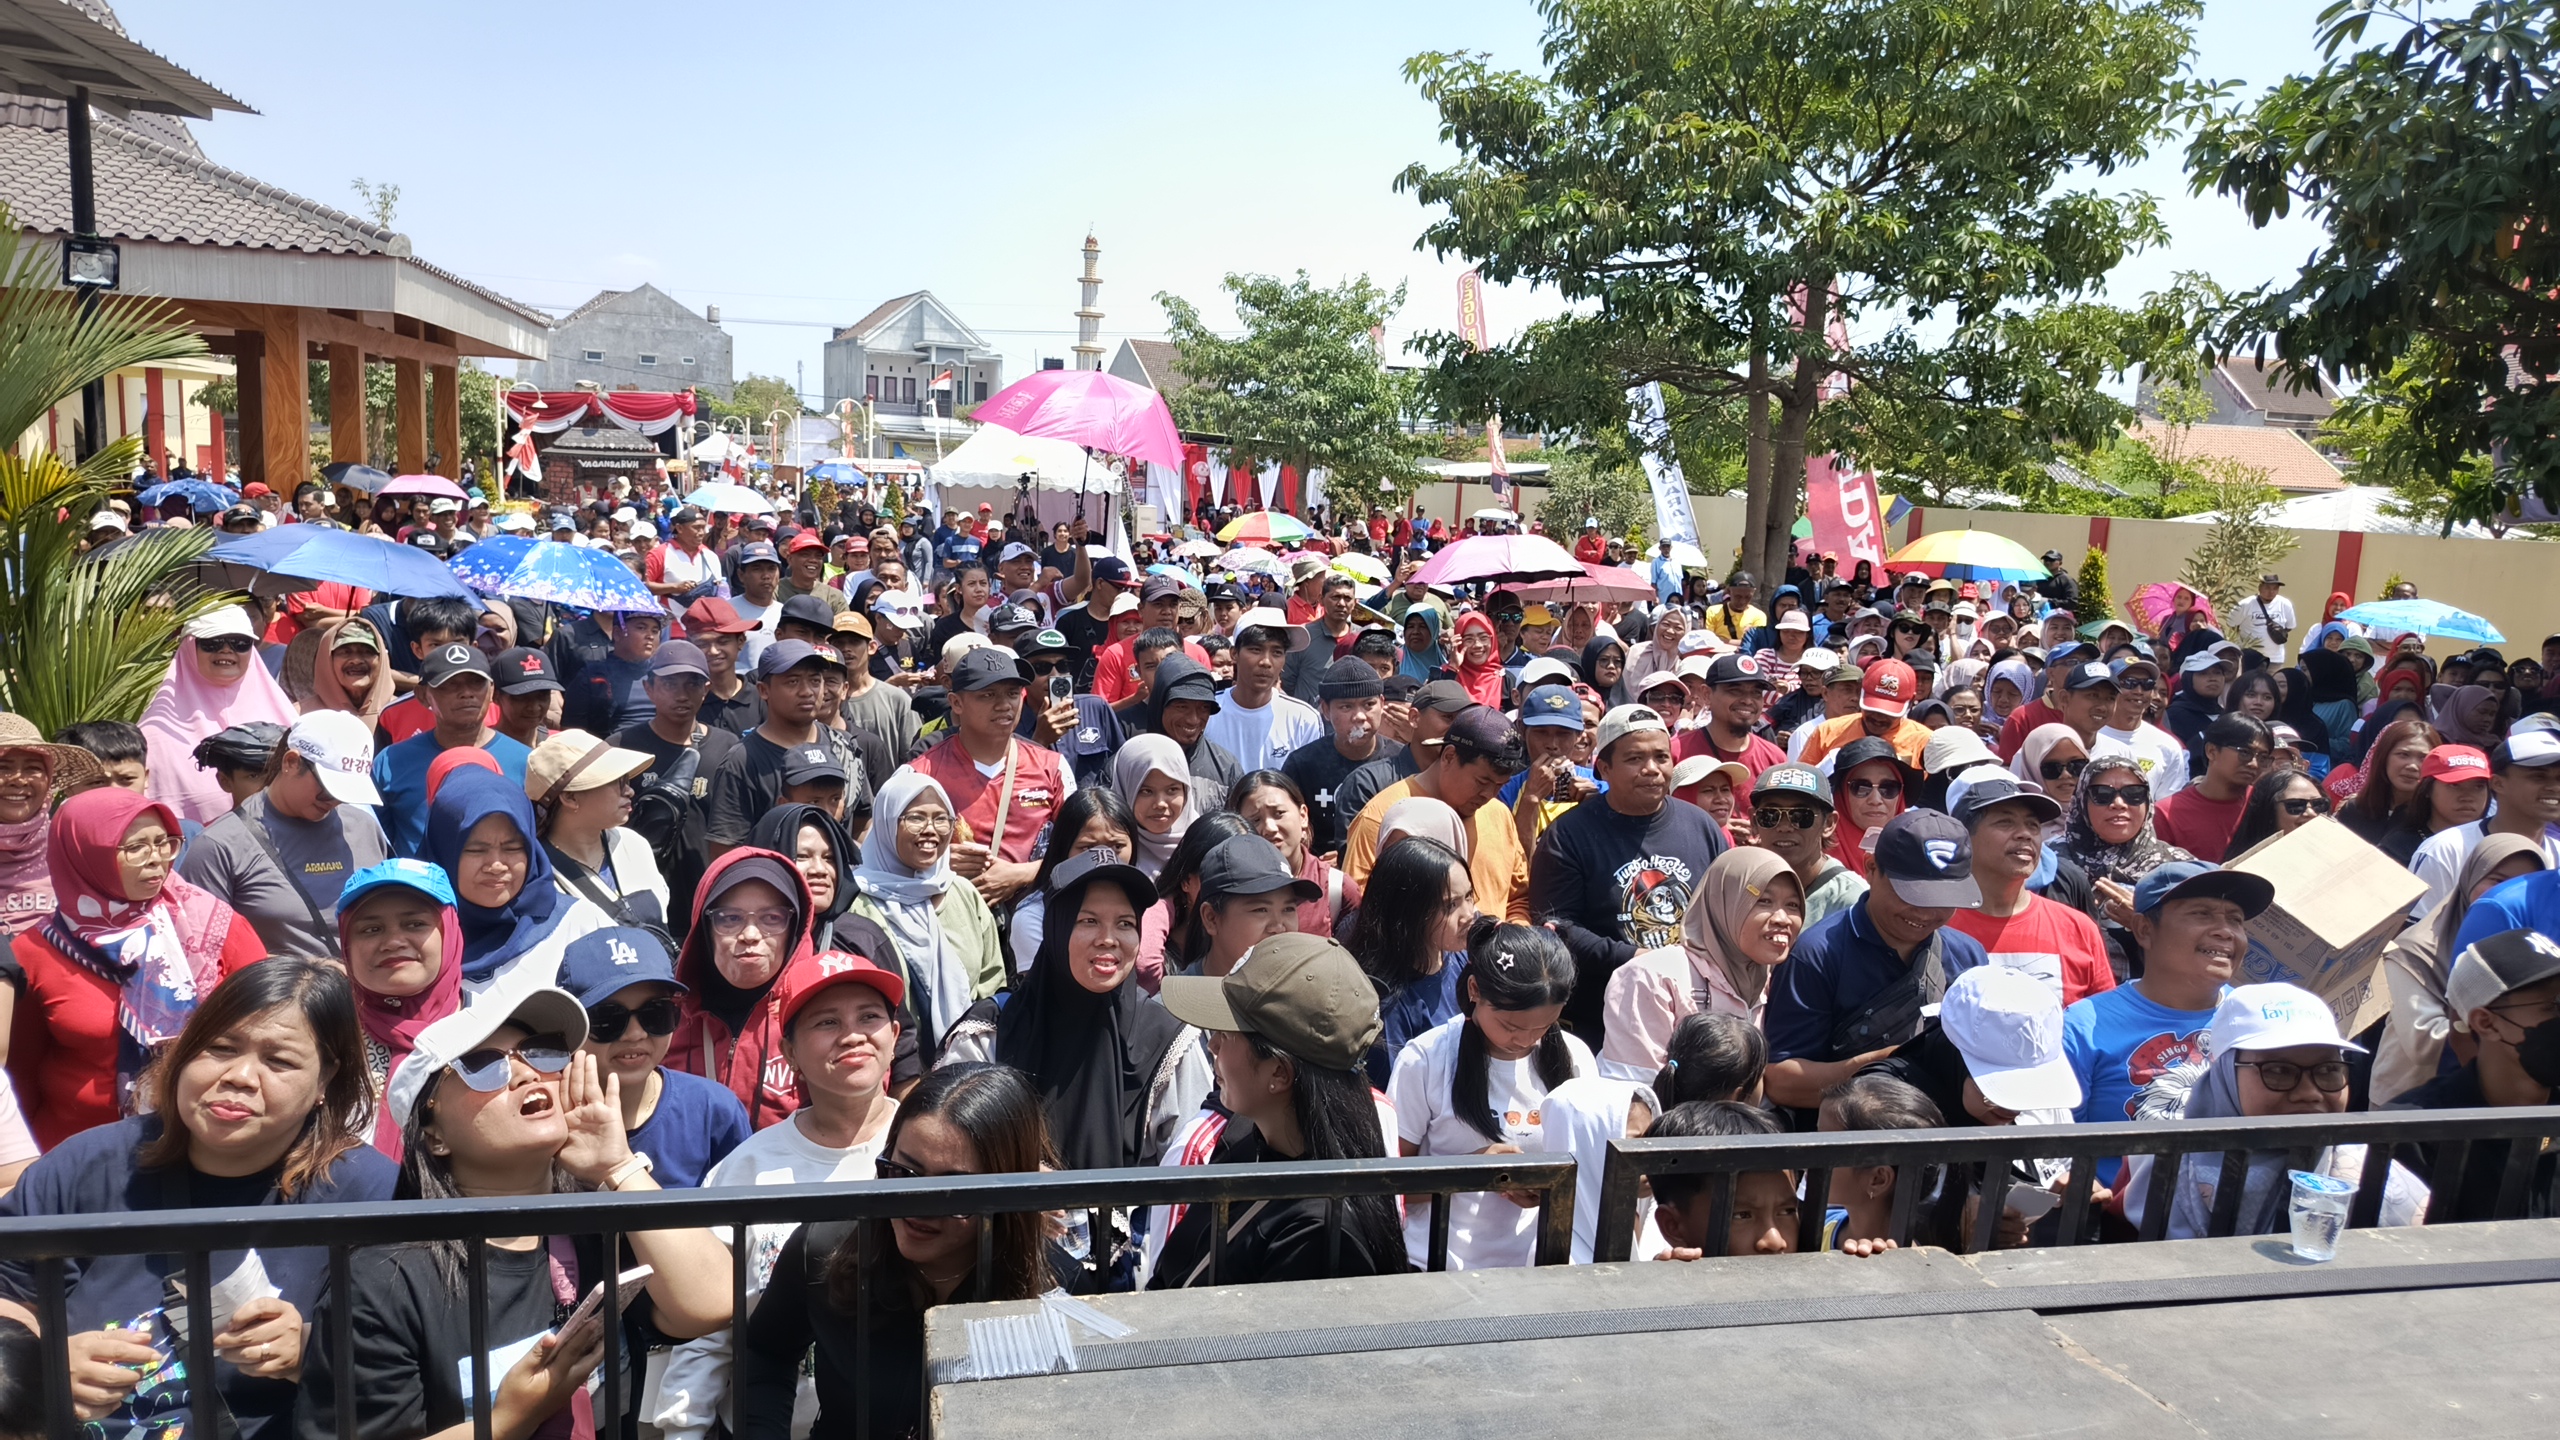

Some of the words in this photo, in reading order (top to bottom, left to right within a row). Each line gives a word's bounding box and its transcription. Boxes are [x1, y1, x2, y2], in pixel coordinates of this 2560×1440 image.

[305, 861, 344, 873] ARMANI
[606, 938, 638, 965] LA
[2156, 1044, 2188, 1062] SINGO
